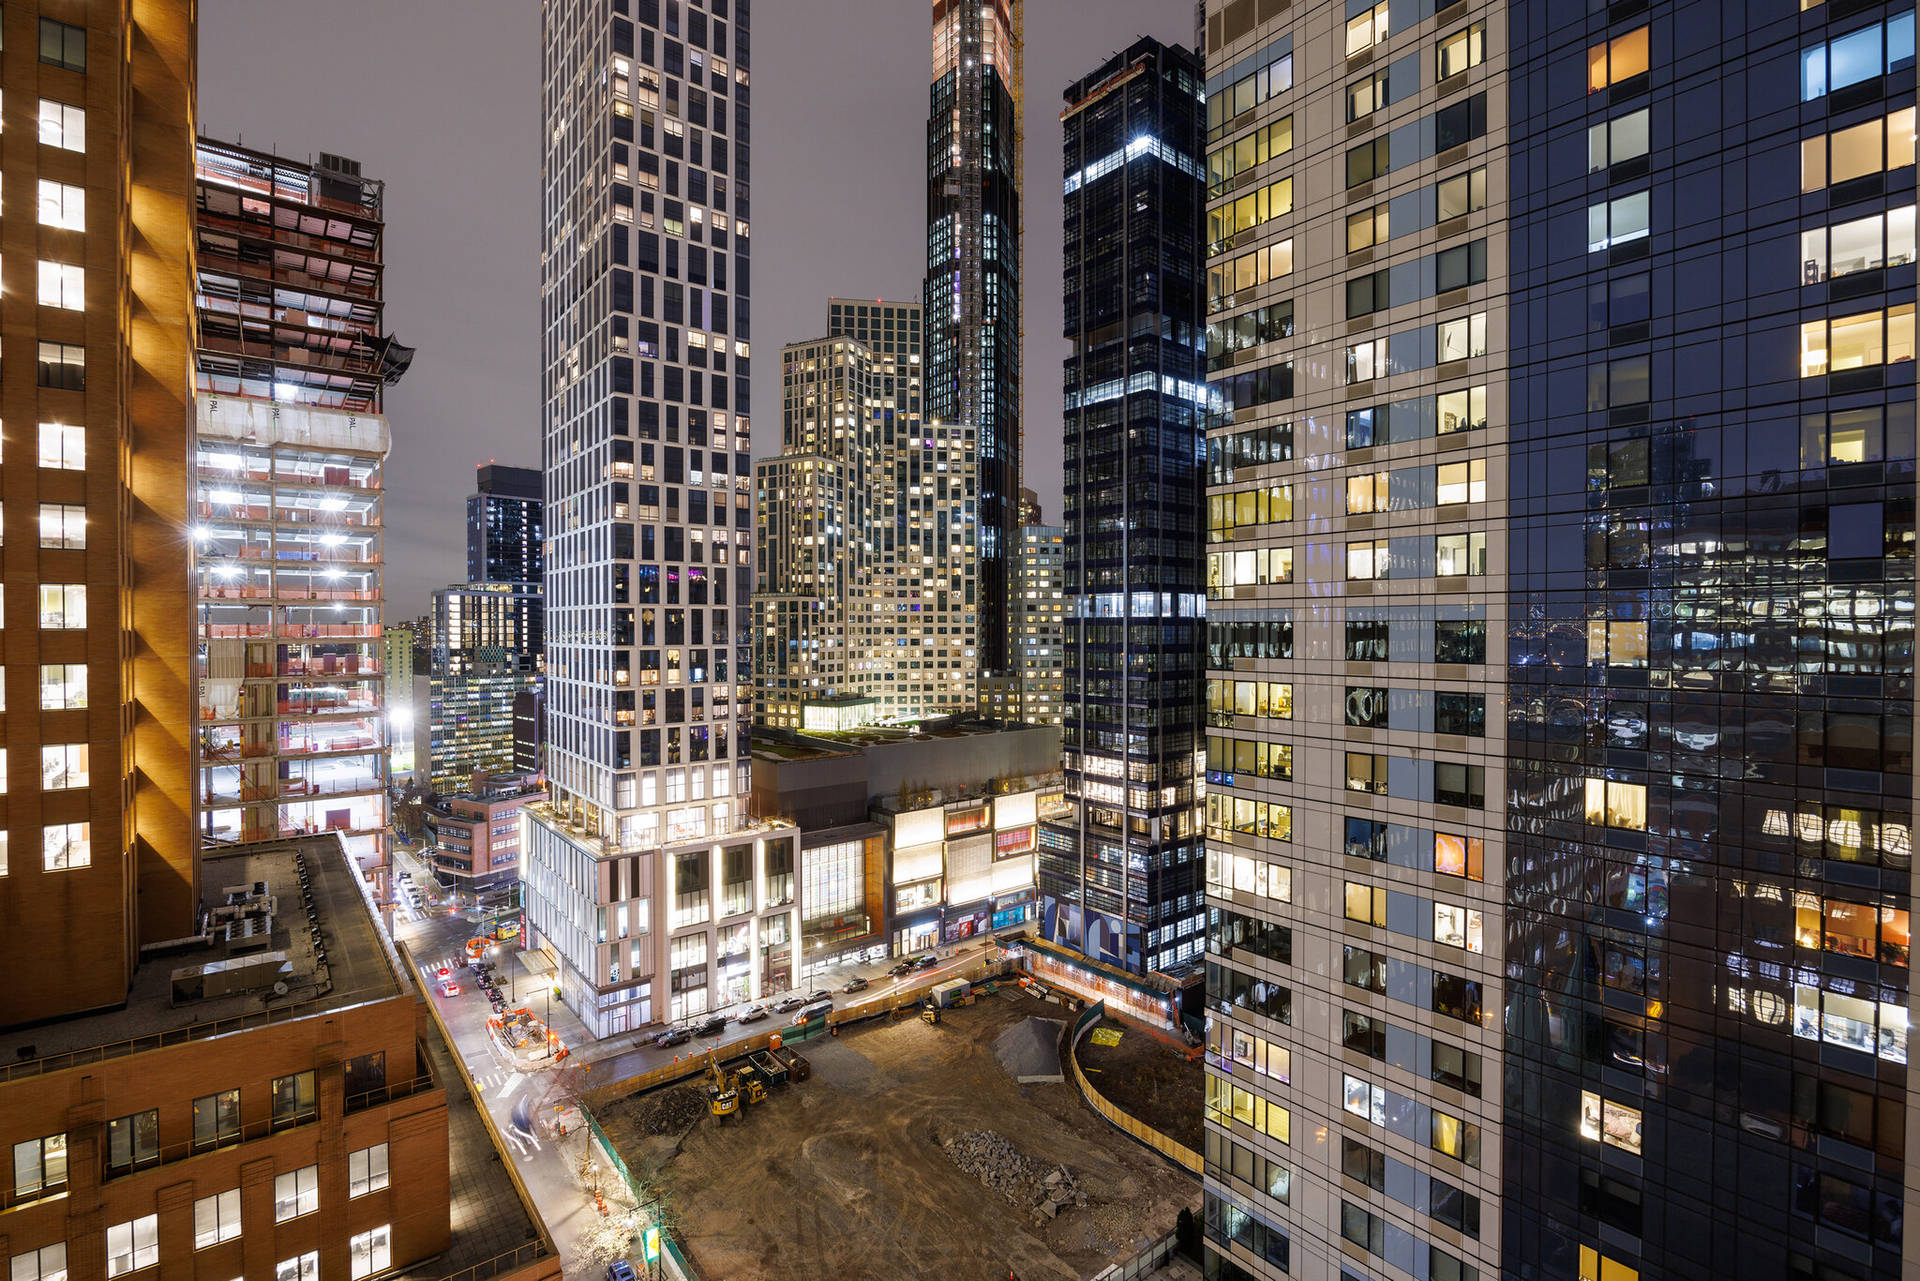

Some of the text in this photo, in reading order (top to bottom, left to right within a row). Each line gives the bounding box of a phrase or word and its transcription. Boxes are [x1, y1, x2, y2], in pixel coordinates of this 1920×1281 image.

[209, 400, 218, 414] PAL
[272, 407, 280, 420] PAL
[348, 417, 357, 429] PAL
[824, 952, 840, 960] CITY
[721, 1101, 732, 1110] CAT
